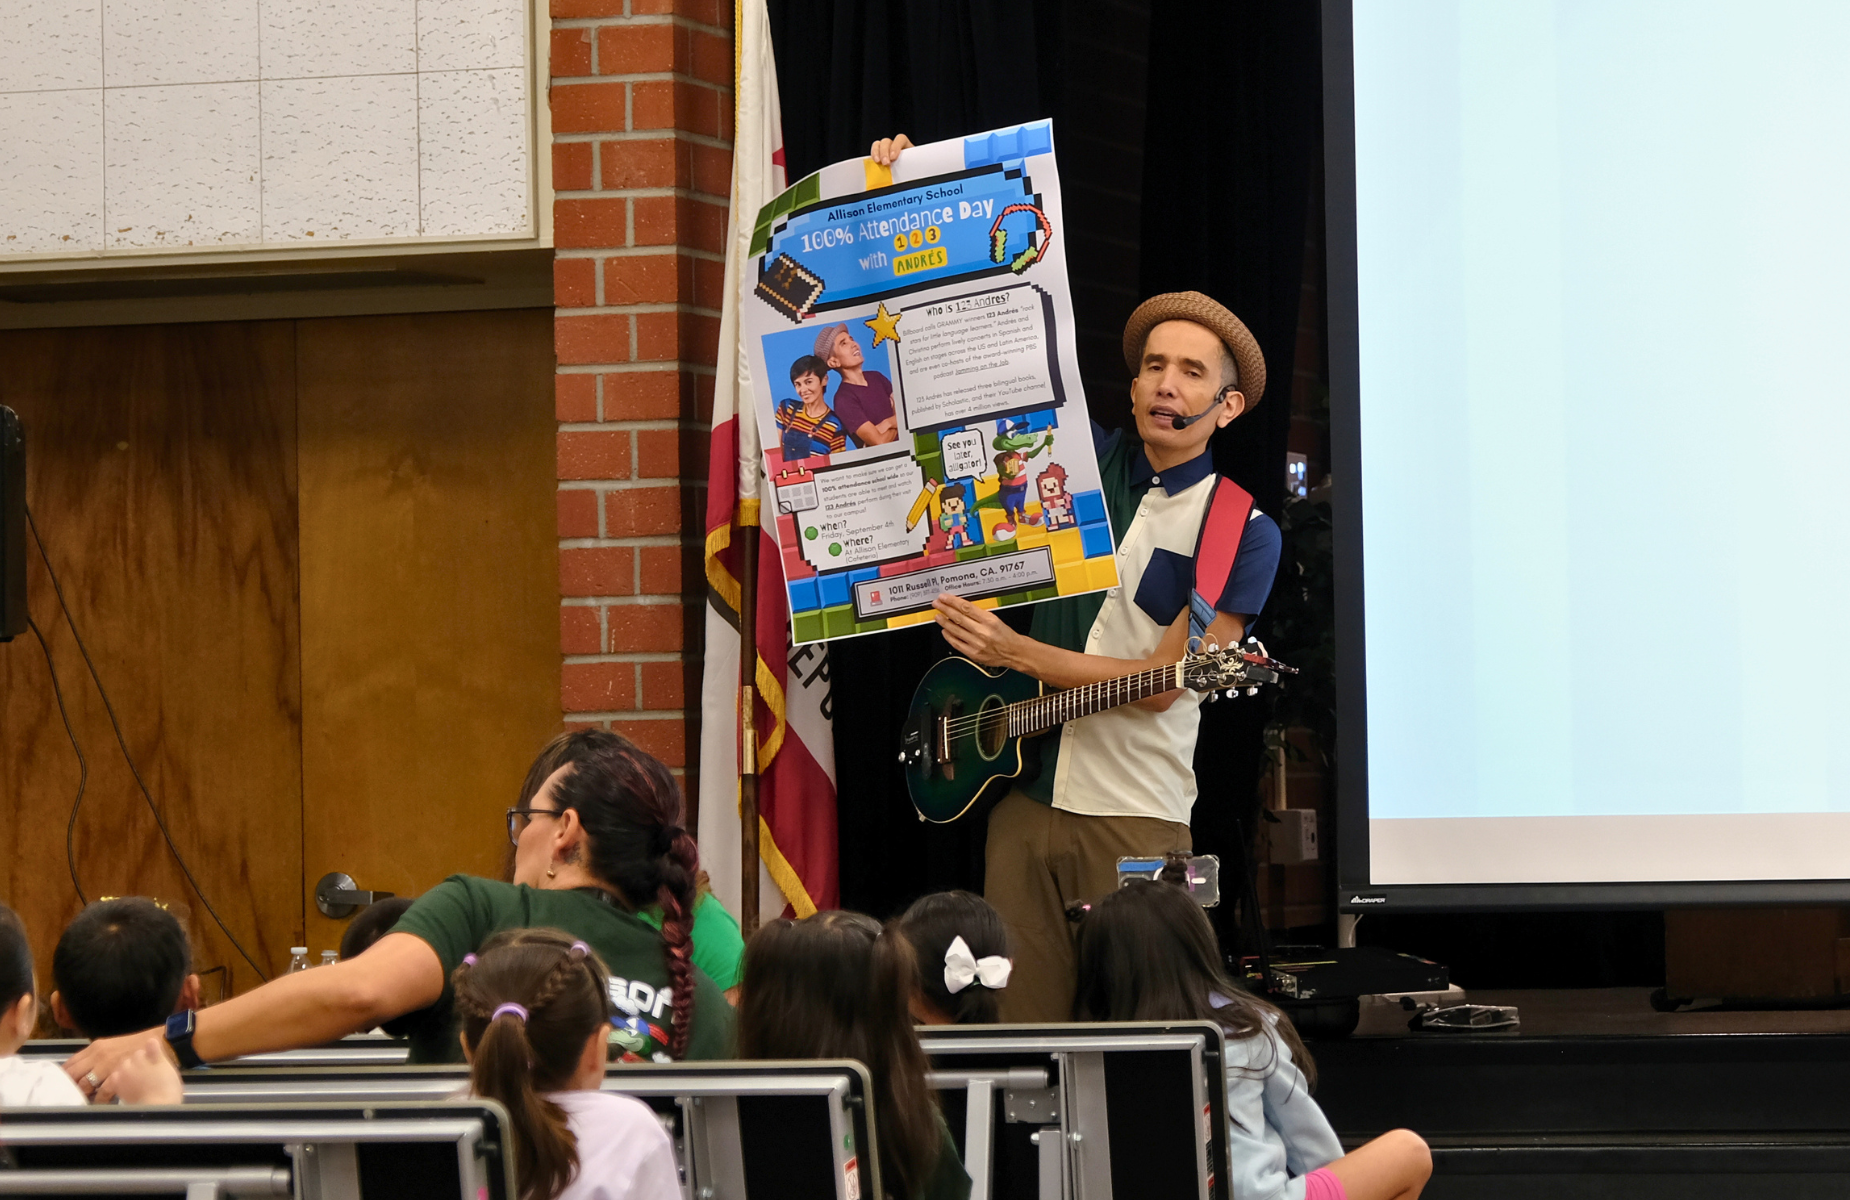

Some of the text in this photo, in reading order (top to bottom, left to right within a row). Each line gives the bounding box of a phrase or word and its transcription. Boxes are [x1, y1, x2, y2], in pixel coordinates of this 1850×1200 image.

[828, 184, 963, 222] Allison Elementary School
[801, 199, 994, 252] 100% Attendance Day
[859, 250, 943, 273] with ANDRÉS
[956, 300, 970, 311] 123
[975, 292, 1009, 306] Andres?
[902, 326, 923, 336] Billboard
[936, 318, 962, 328] GRAMMY
[942, 328, 968, 337] language
[908, 346, 930, 355] Christina
[930, 342, 950, 351] perform
[967, 334, 991, 342] concerts
[998, 327, 1021, 337] Spanish
[905, 357, 922, 366] English
[941, 359, 964, 368] co-hosts
[983, 347, 1024, 359] award-winning
[933, 370, 954, 380] podcast
[955, 366, 979, 376] Jamming
[953, 385, 976, 394] released
[993, 376, 1017, 387] bilingual
[911, 404, 934, 416] published
[942, 398, 970, 408] Scholastic,
[998, 387, 1022, 396] YouTube
[1023, 382, 1046, 392] channel
[947, 438, 976, 450] See you
[954, 451, 972, 460] later,
[949, 459, 982, 472] alligator!
[838, 480, 871, 490] attendance
[858, 497, 878, 505] perform
[844, 506, 866, 516] campus!
[820, 520, 847, 531] When?
[821, 529, 844, 540] Friday,
[845, 524, 883, 536] September
[843, 535, 873, 546] Where?
[877, 539, 909, 550] Elementary
[846, 552, 878, 564] (Cafeteria)
[889, 585, 904, 595] 1011
[906, 578, 931, 592] Russell
[940, 573, 978, 584] Pomona,
[980, 567, 997, 576] CA.
[1000, 561, 1024, 573] 91767
